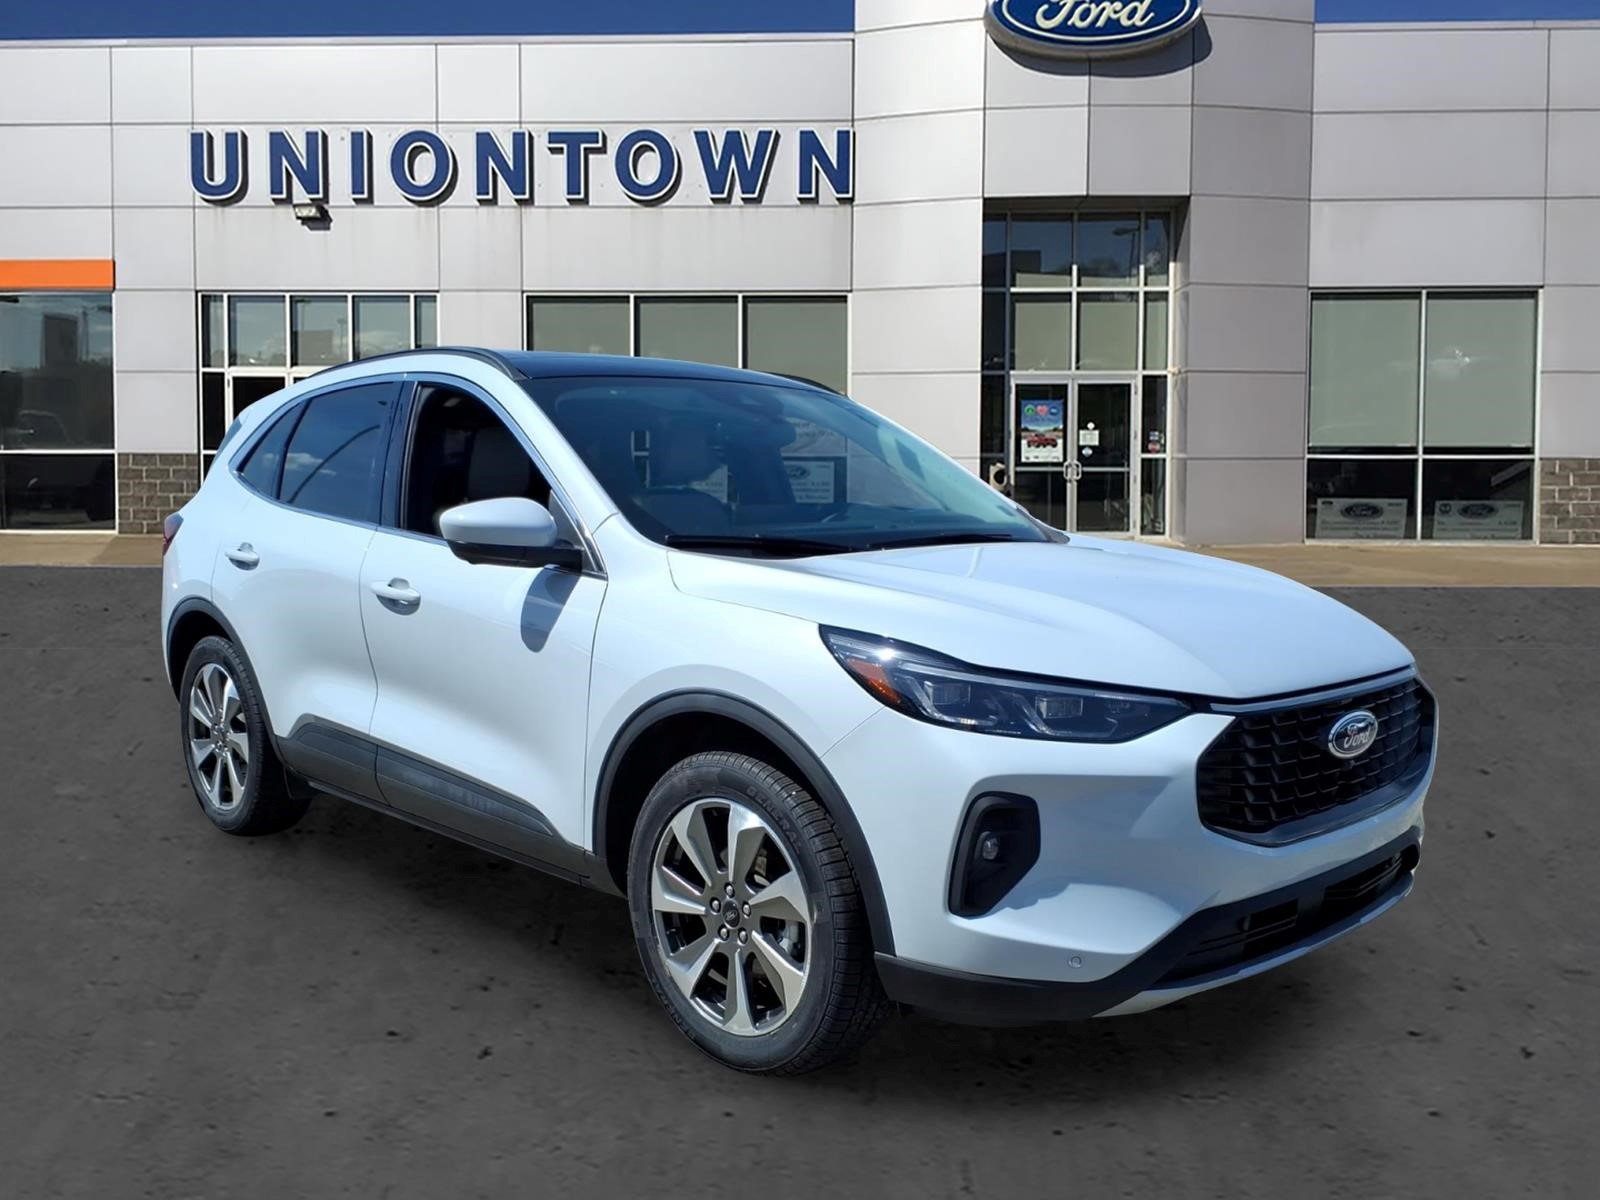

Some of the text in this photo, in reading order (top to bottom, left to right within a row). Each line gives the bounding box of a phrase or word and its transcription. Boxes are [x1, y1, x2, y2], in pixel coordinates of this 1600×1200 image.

[1035, 0, 1155, 29] Ford
[190, 128, 853, 203] UNIONTOWN
[1343, 722, 1372, 749] Ford
